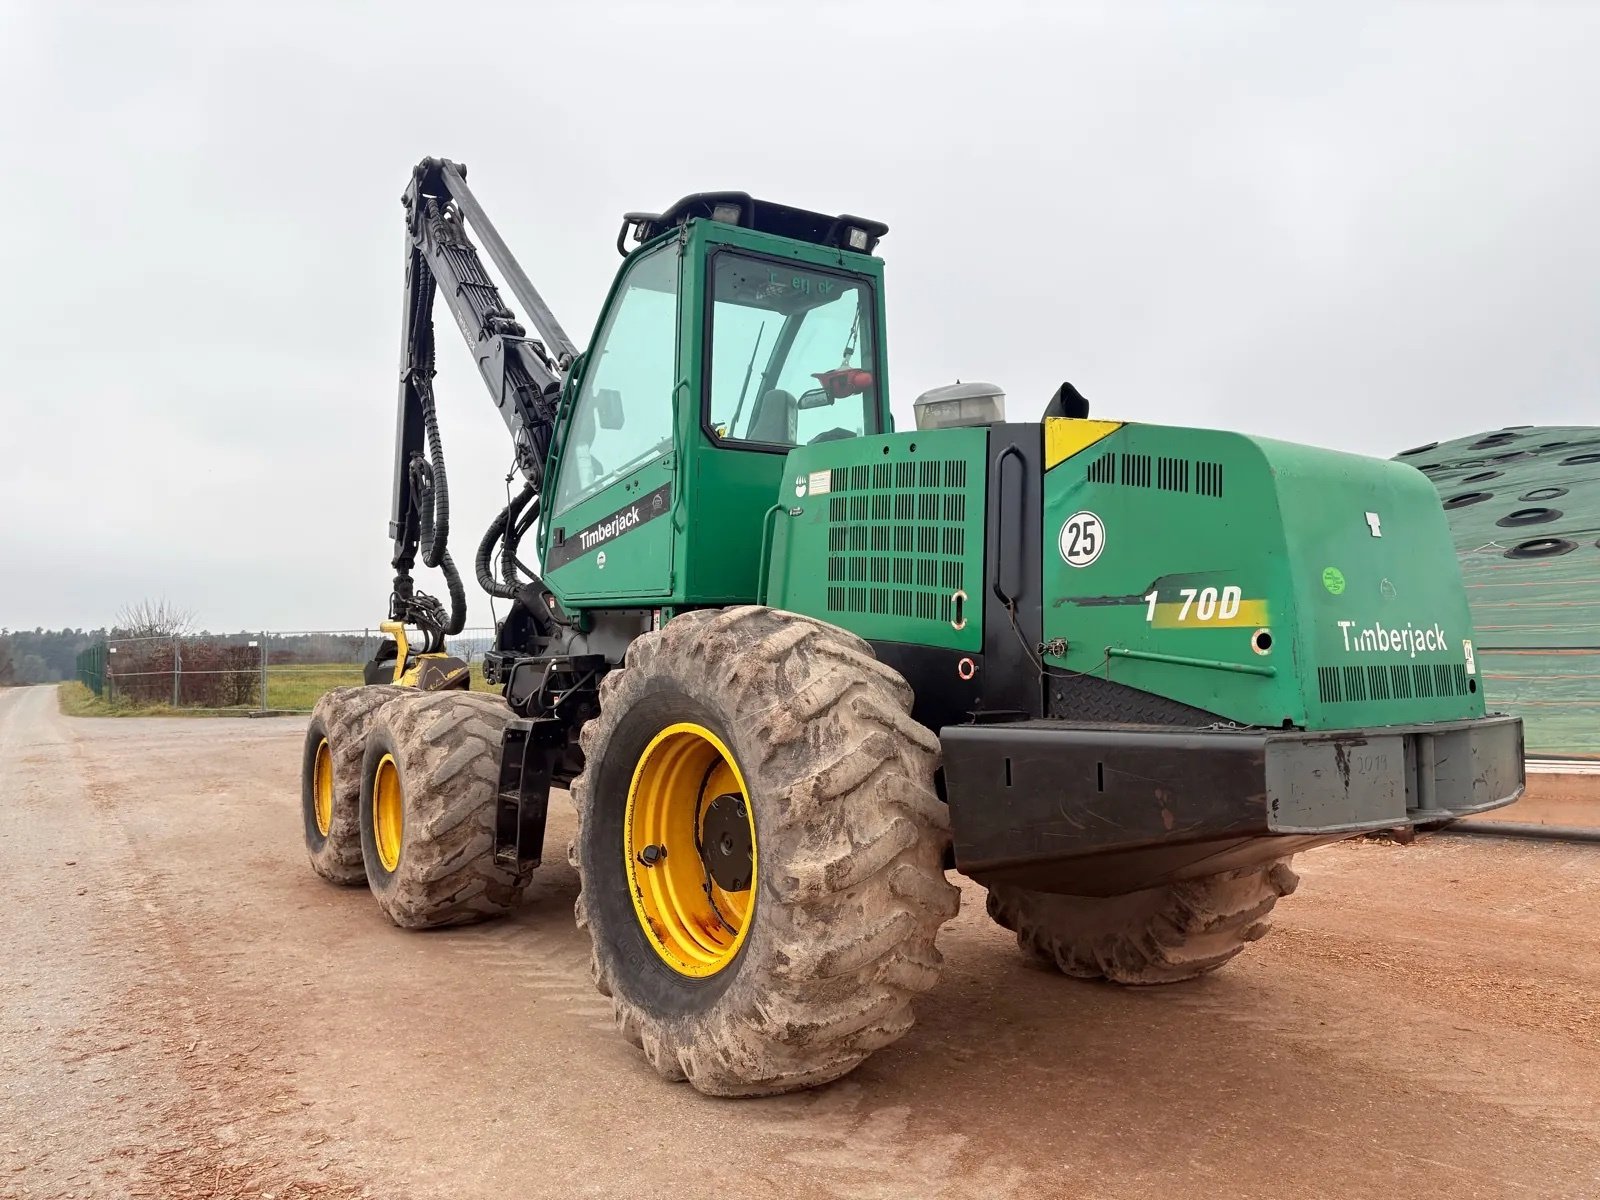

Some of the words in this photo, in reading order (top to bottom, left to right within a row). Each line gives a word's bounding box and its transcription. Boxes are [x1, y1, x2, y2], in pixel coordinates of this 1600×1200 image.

[579, 506, 640, 550] Timberjack
[1068, 521, 1095, 557] 25
[1178, 586, 1242, 621] 70D
[1338, 621, 1447, 658] Timberjack
